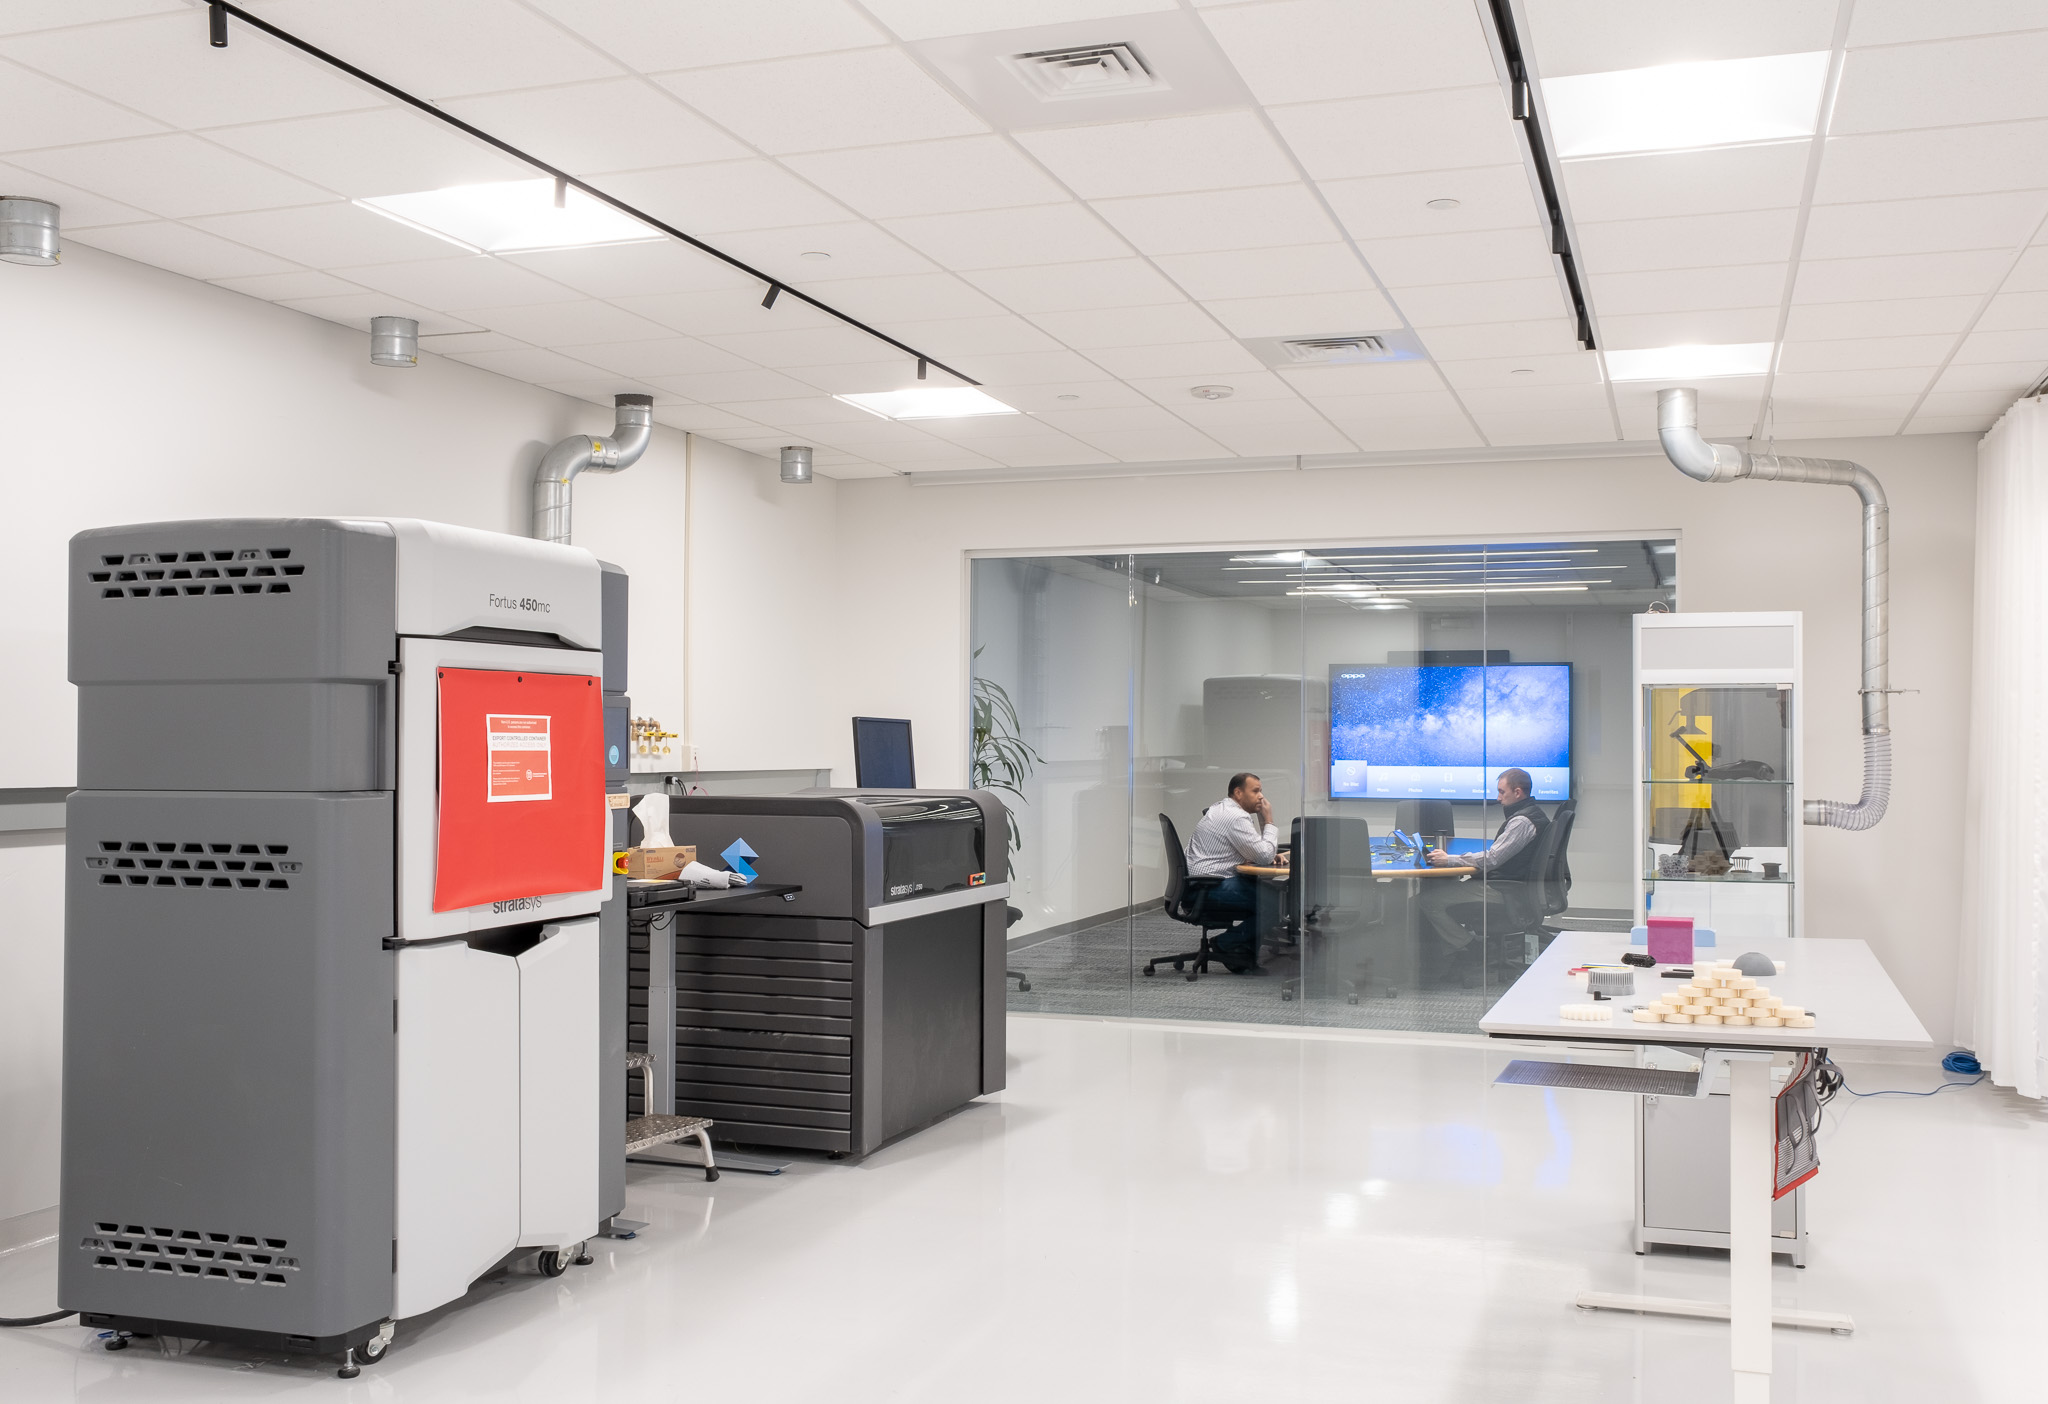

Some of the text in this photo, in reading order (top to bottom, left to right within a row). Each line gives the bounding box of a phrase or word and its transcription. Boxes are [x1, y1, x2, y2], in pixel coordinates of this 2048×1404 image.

[489, 593, 551, 614] Fortus 450mc
[890, 884, 913, 896] stratasys
[493, 896, 542, 914] stratasys
